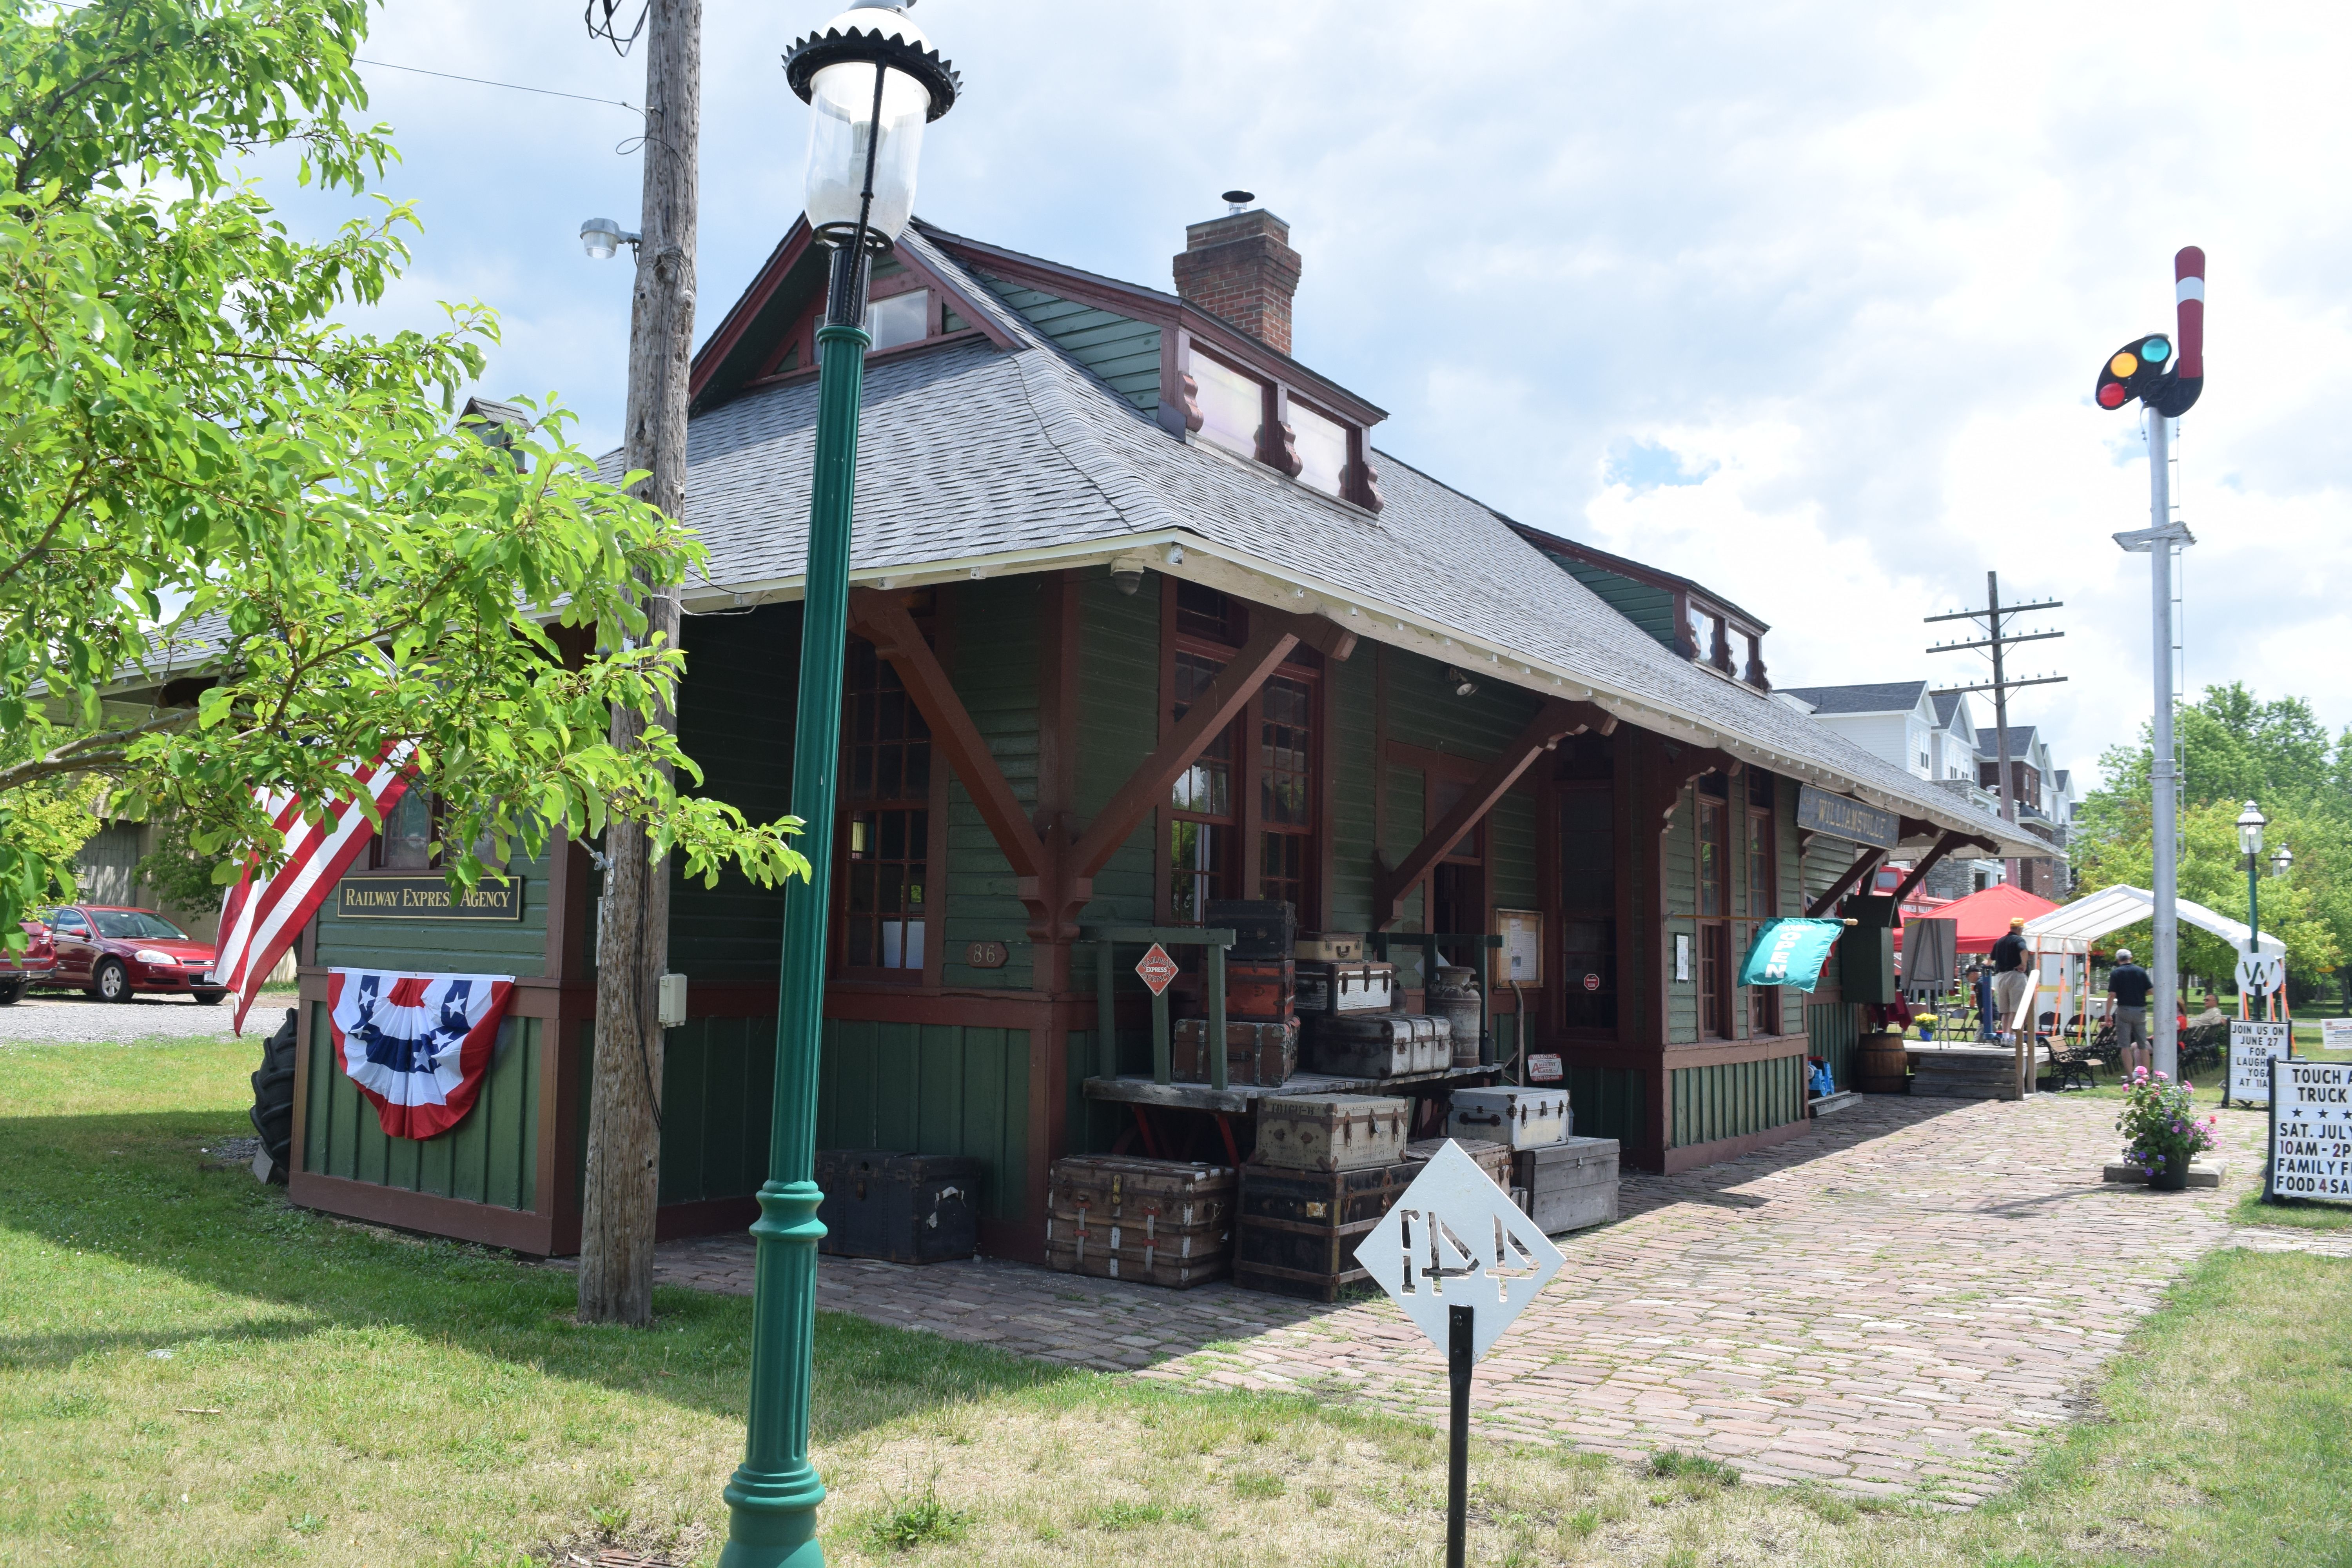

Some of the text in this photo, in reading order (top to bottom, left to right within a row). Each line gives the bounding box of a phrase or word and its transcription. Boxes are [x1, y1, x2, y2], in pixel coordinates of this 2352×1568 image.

[1818, 799, 1886, 839] WILLIAMSVILLE
[403, 888, 451, 907] EXPRES
[974, 944, 995, 962] 86
[1765, 932, 1801, 978] OPEN
[1141, 956, 1174, 969] RAILWAY
[1141, 970, 1171, 982] AGENCY
[2232, 1025, 2284, 1036] JOIN US ON
[2241, 1036, 2278, 1046] JUNE 27
[2250, 1047, 2267, 1056] FOR
[2239, 1078, 2250, 1087] AT
[2292, 1069, 2341, 1085] TOUCH
[2298, 1087, 2347, 1103] TRUCK
[2280, 1122, 2314, 1138] SAT.
[2280, 1140, 2318, 1156] 10AM
[2278, 1158, 2352, 1176] FAMILY F
[2276, 1175, 2352, 1194] FOOD 4 SA
